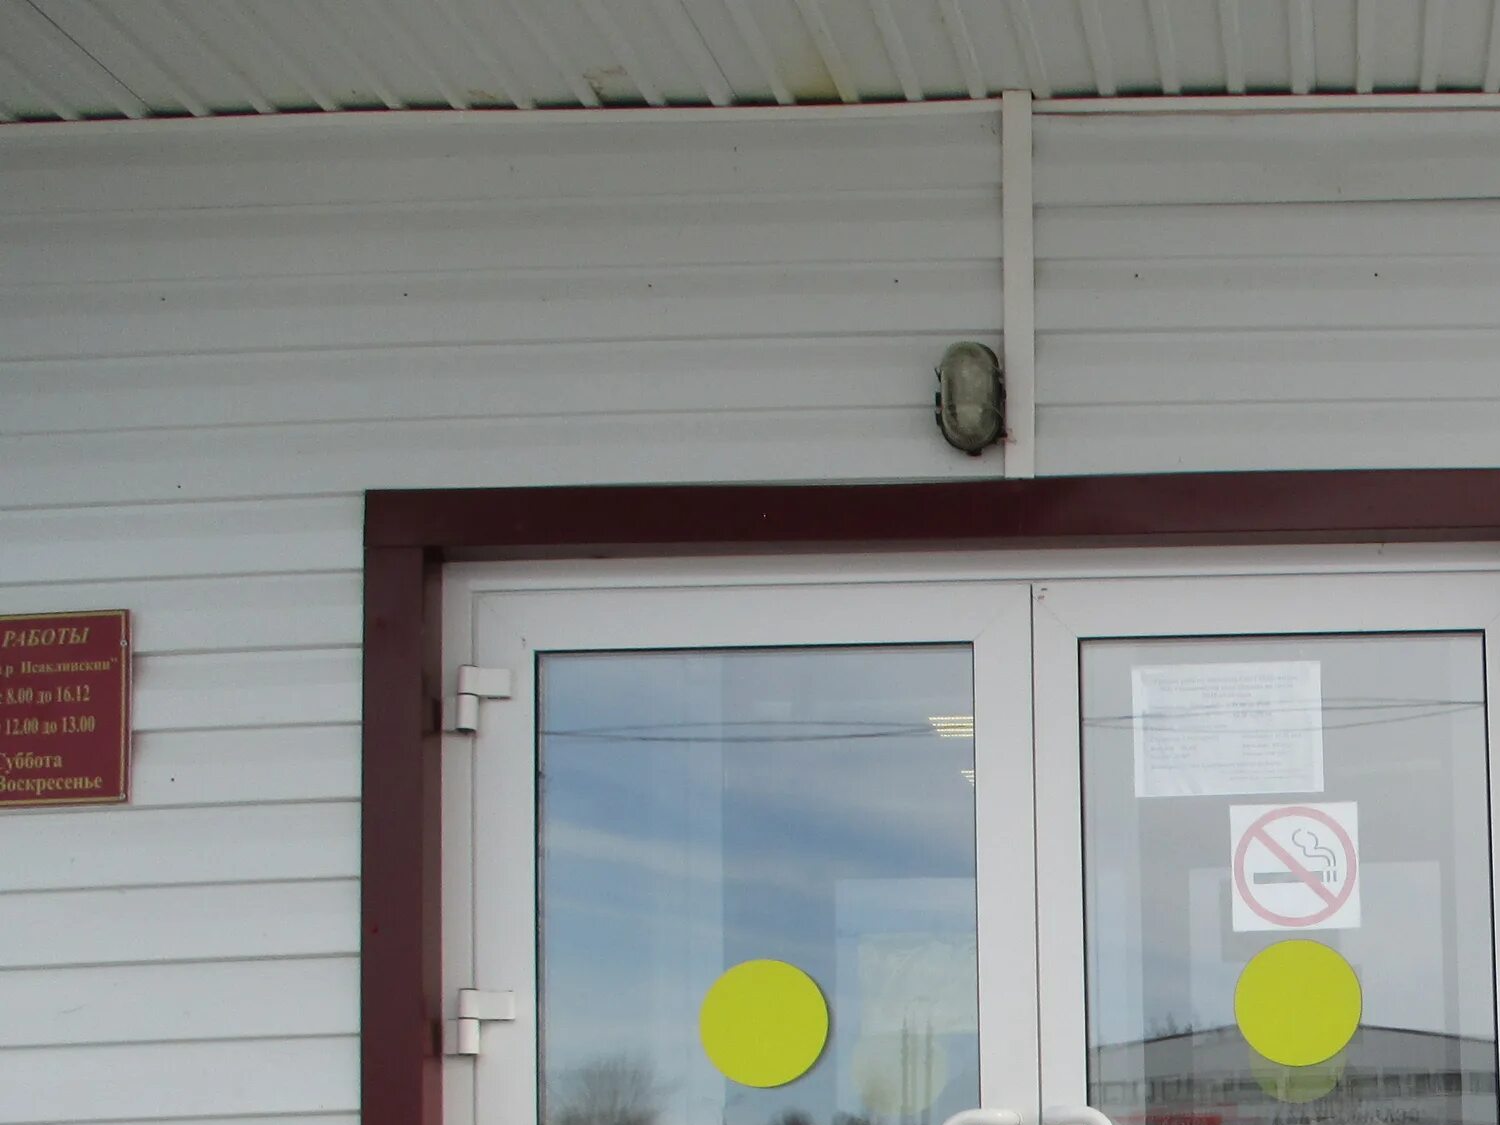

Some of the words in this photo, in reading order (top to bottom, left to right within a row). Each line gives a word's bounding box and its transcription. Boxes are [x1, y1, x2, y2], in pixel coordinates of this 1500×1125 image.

[2, 628, 90, 647] РАБОТЫ
[37, 690, 52, 704] до
[57, 685, 90, 702] 16.12
[42, 722, 57, 734] до
[62, 716, 95, 733] 13.00
